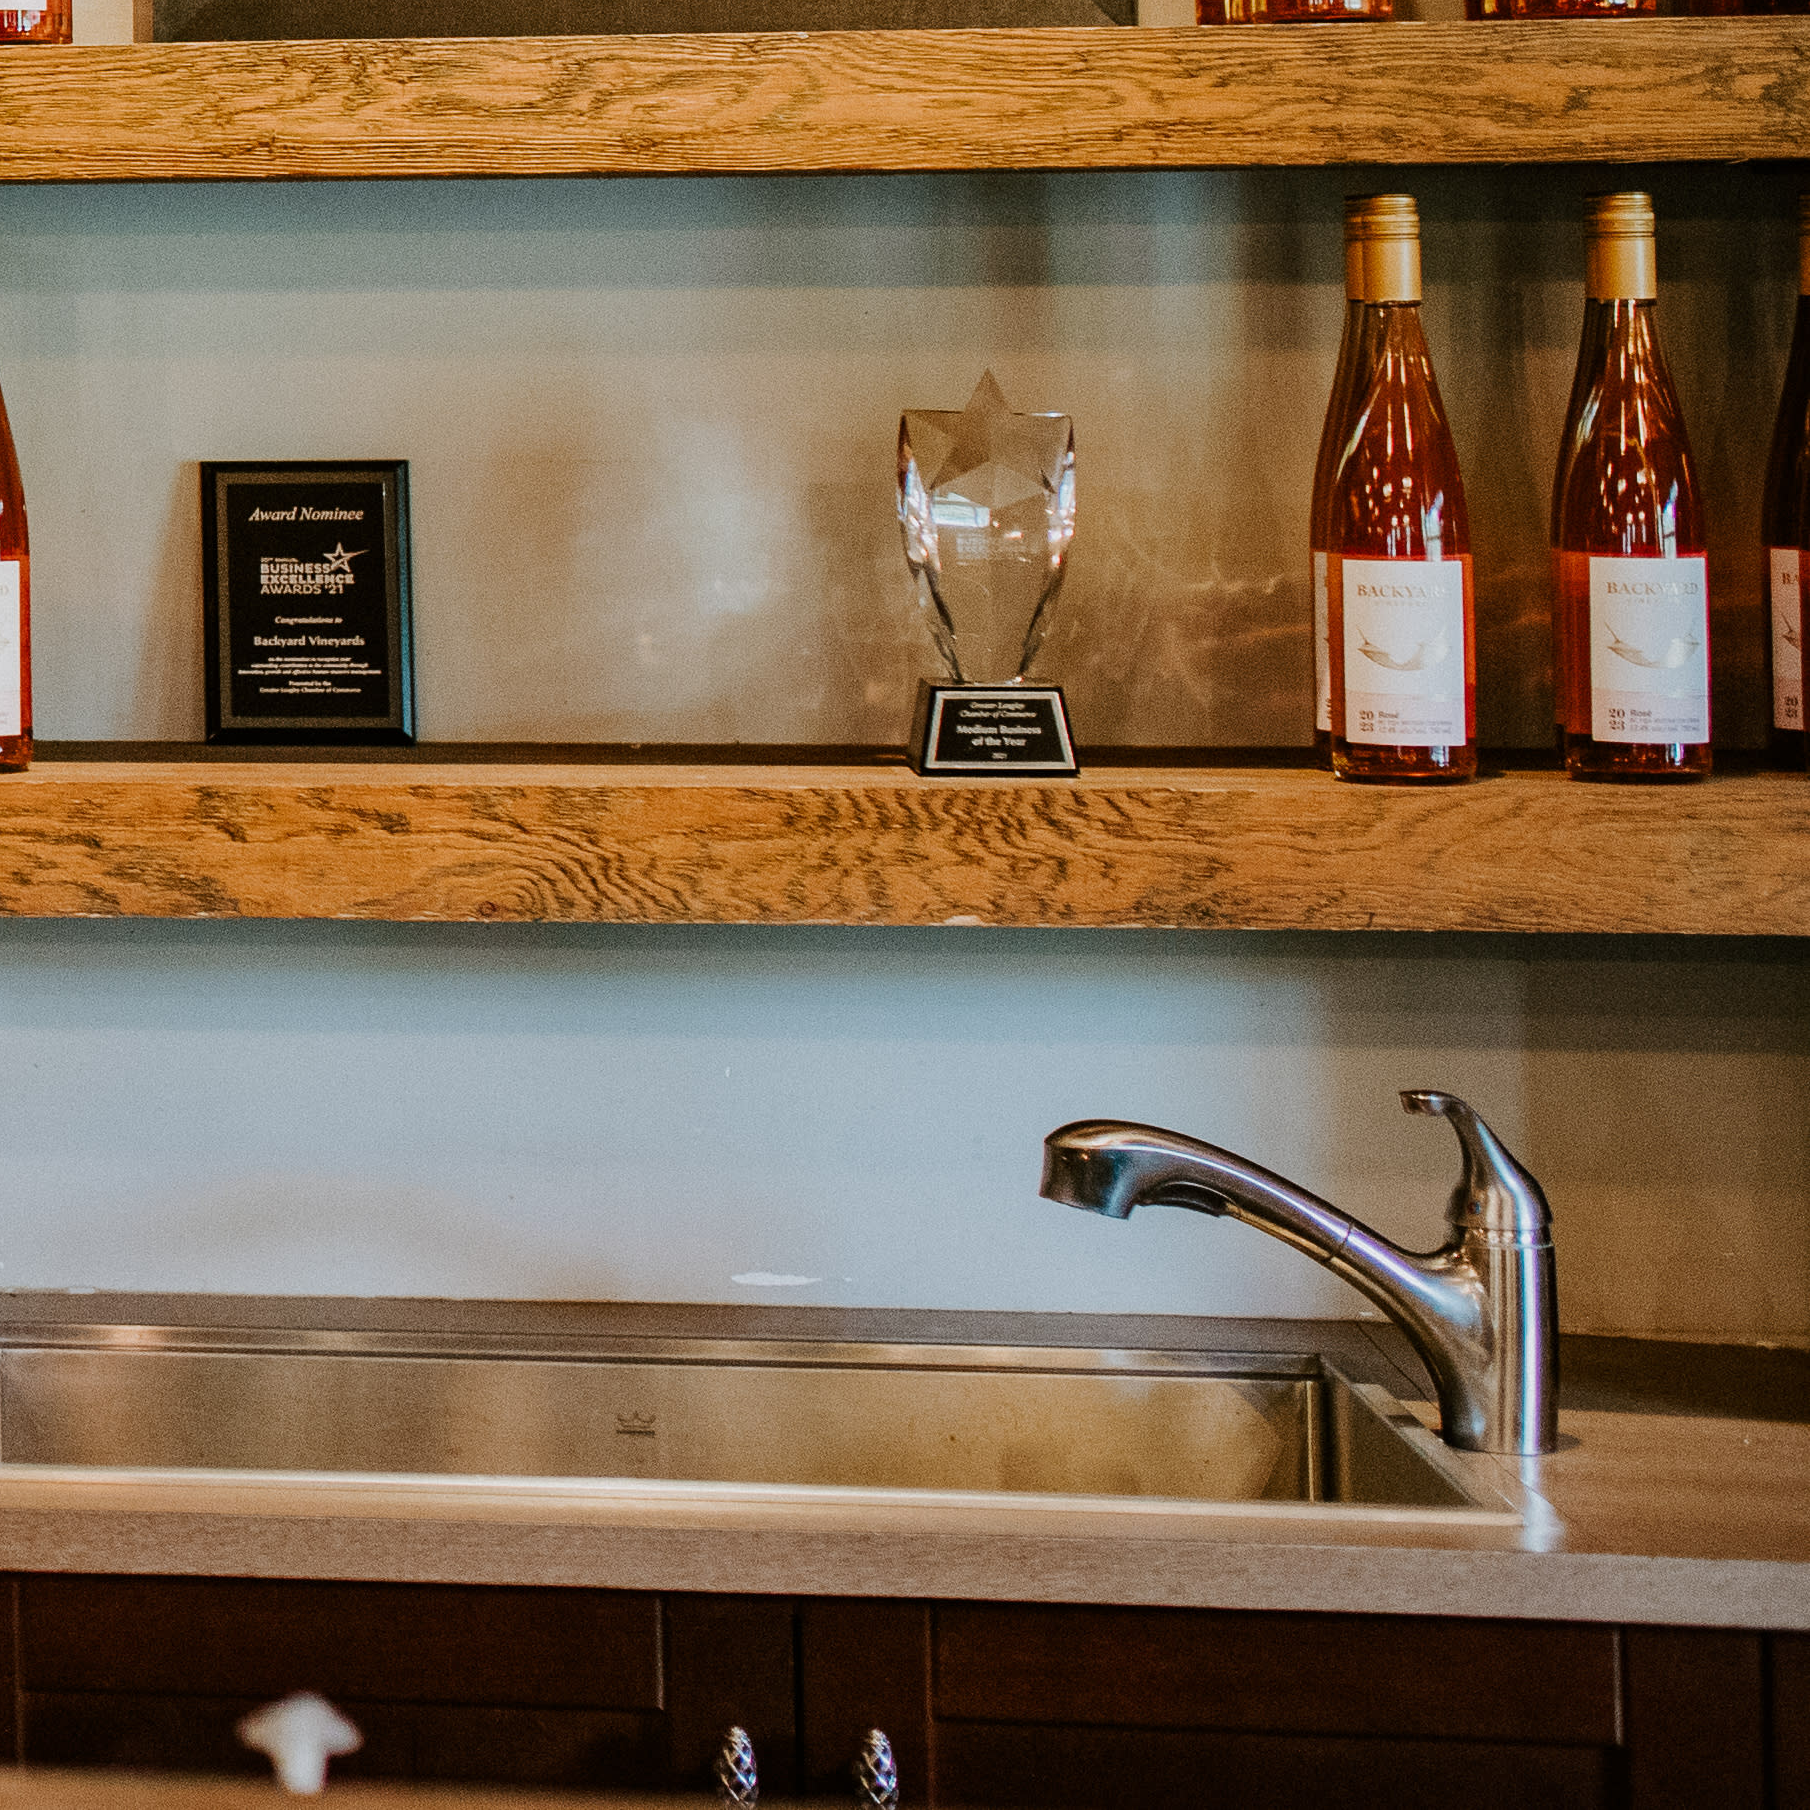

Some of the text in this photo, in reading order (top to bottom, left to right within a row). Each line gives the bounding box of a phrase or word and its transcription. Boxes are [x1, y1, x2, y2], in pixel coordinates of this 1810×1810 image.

[247, 506, 364, 522] Award Nominee
[260, 563, 332, 574] BUSINESS
[260, 574, 356, 584] EXCELLENCE
[260, 584, 322, 595] AWARDS
[253, 635, 366, 648] Backyard Vineyards
[1359, 710, 1374, 720] 20
[1608, 708, 1625, 719] 20
[956, 724, 1042, 734] Medium Business
[971, 736, 1027, 746] of the Year
